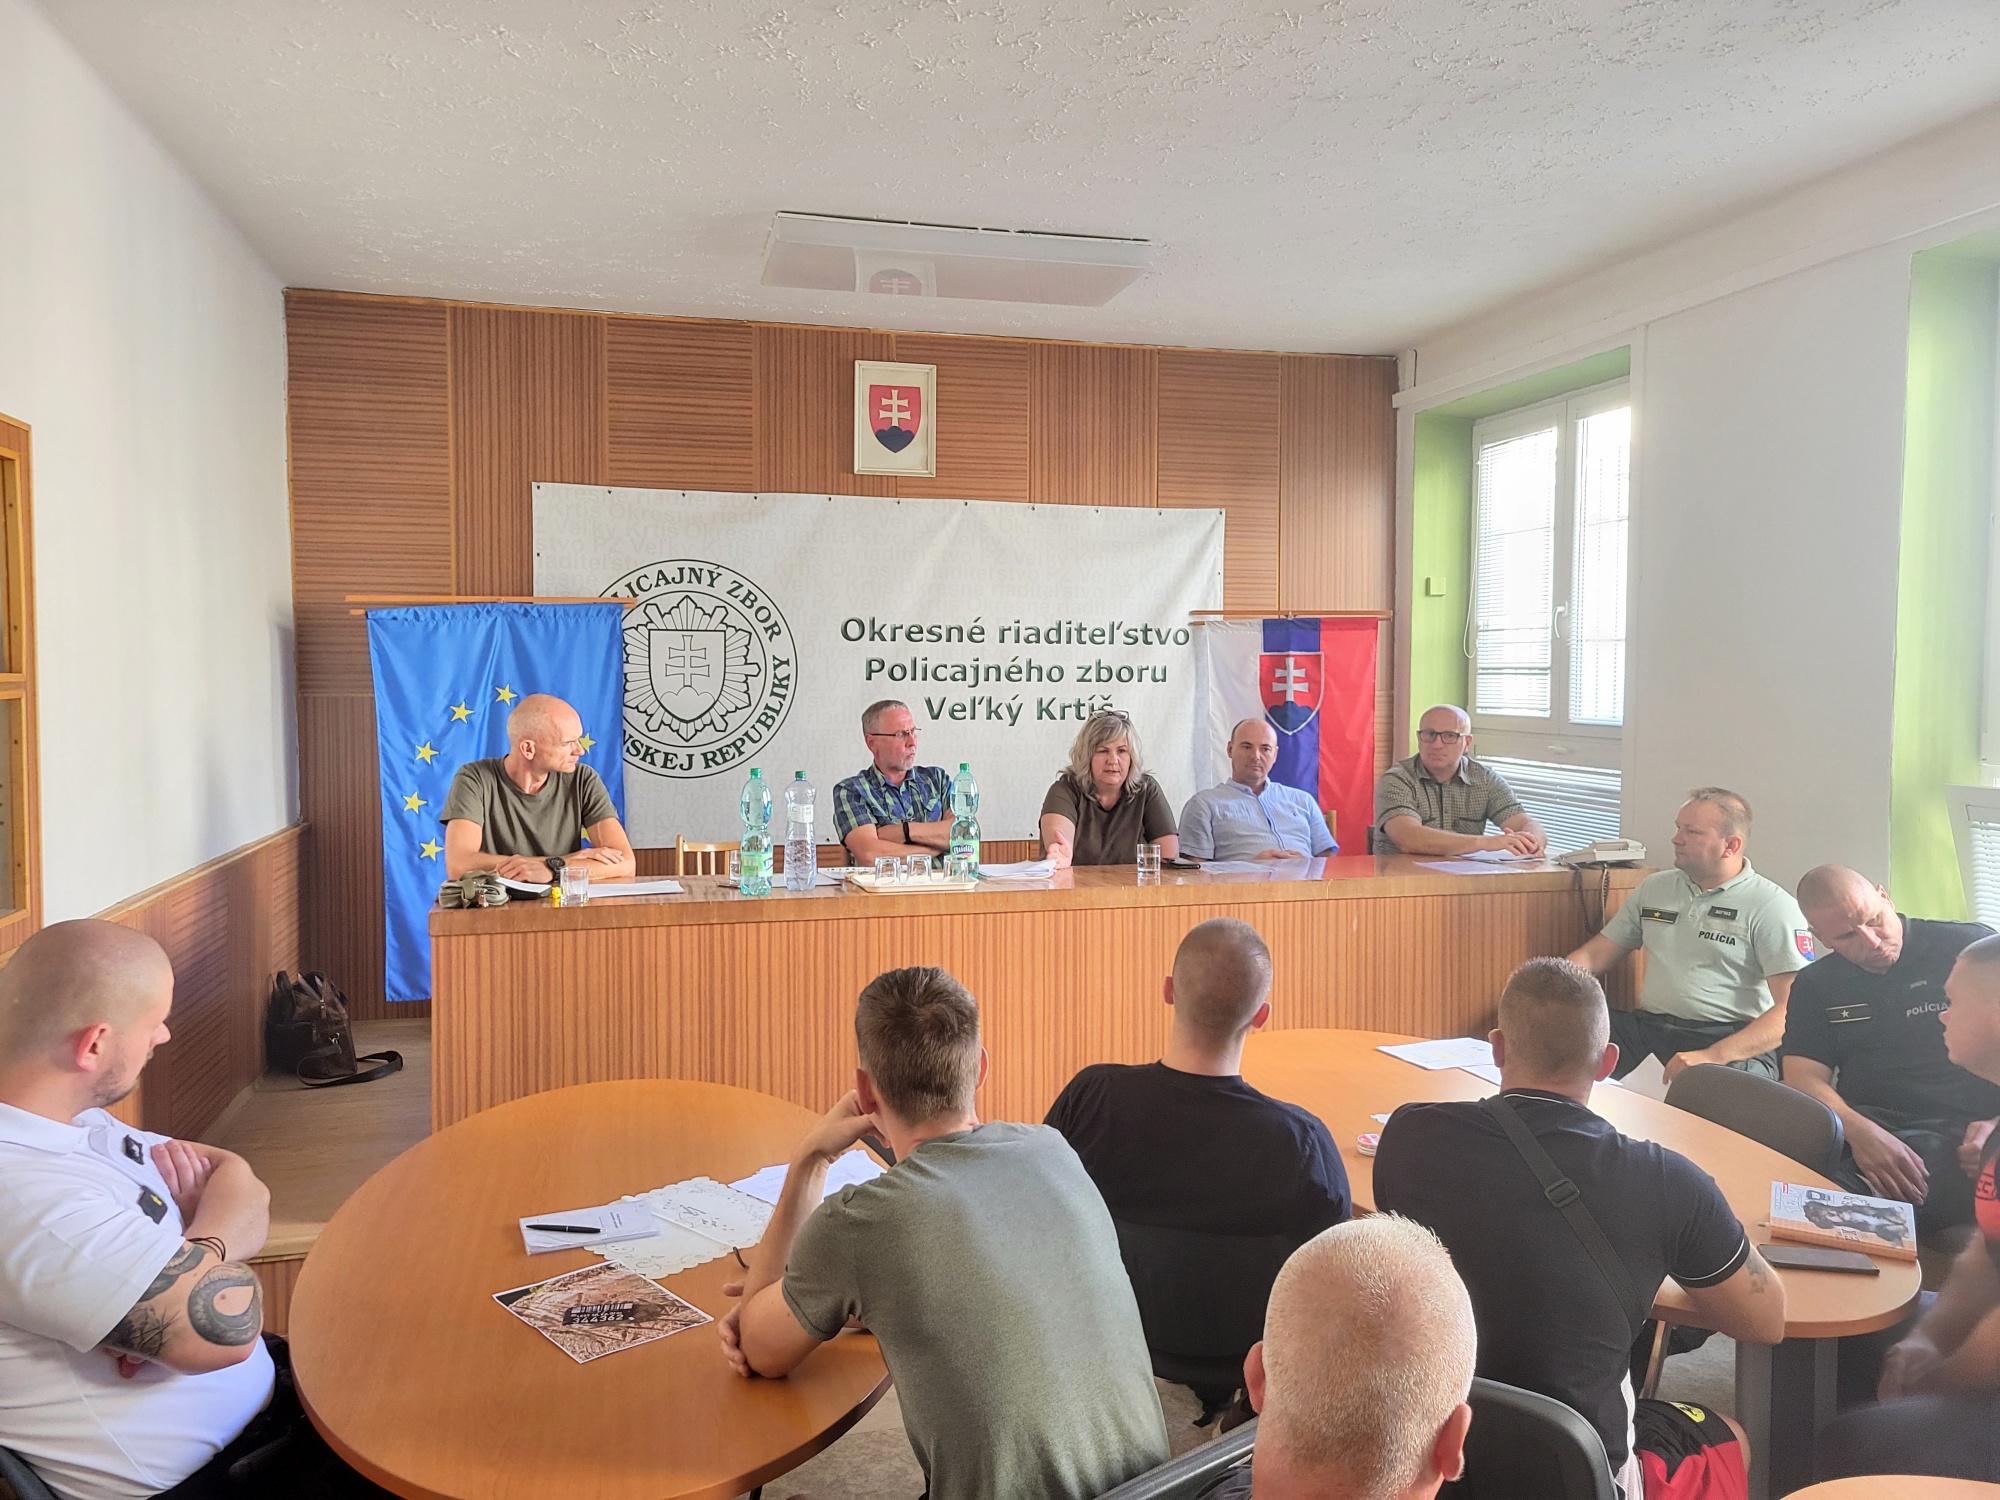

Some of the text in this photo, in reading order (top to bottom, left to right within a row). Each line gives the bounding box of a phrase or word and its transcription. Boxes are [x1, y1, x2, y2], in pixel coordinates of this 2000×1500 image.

[611, 566, 782, 642] ICAJNÝ ZBOR
[840, 616, 985, 643] Okresné
[998, 619, 1190, 646] riaditeľstvo
[865, 656, 1168, 688] Policajného zboru
[700, 654, 790, 769] REPUBLIKY
[923, 694, 1023, 726] Veľký
[1698, 930, 1736, 946] POLÍCIA
[1906, 1002, 1949, 1018] POLÍCIA
